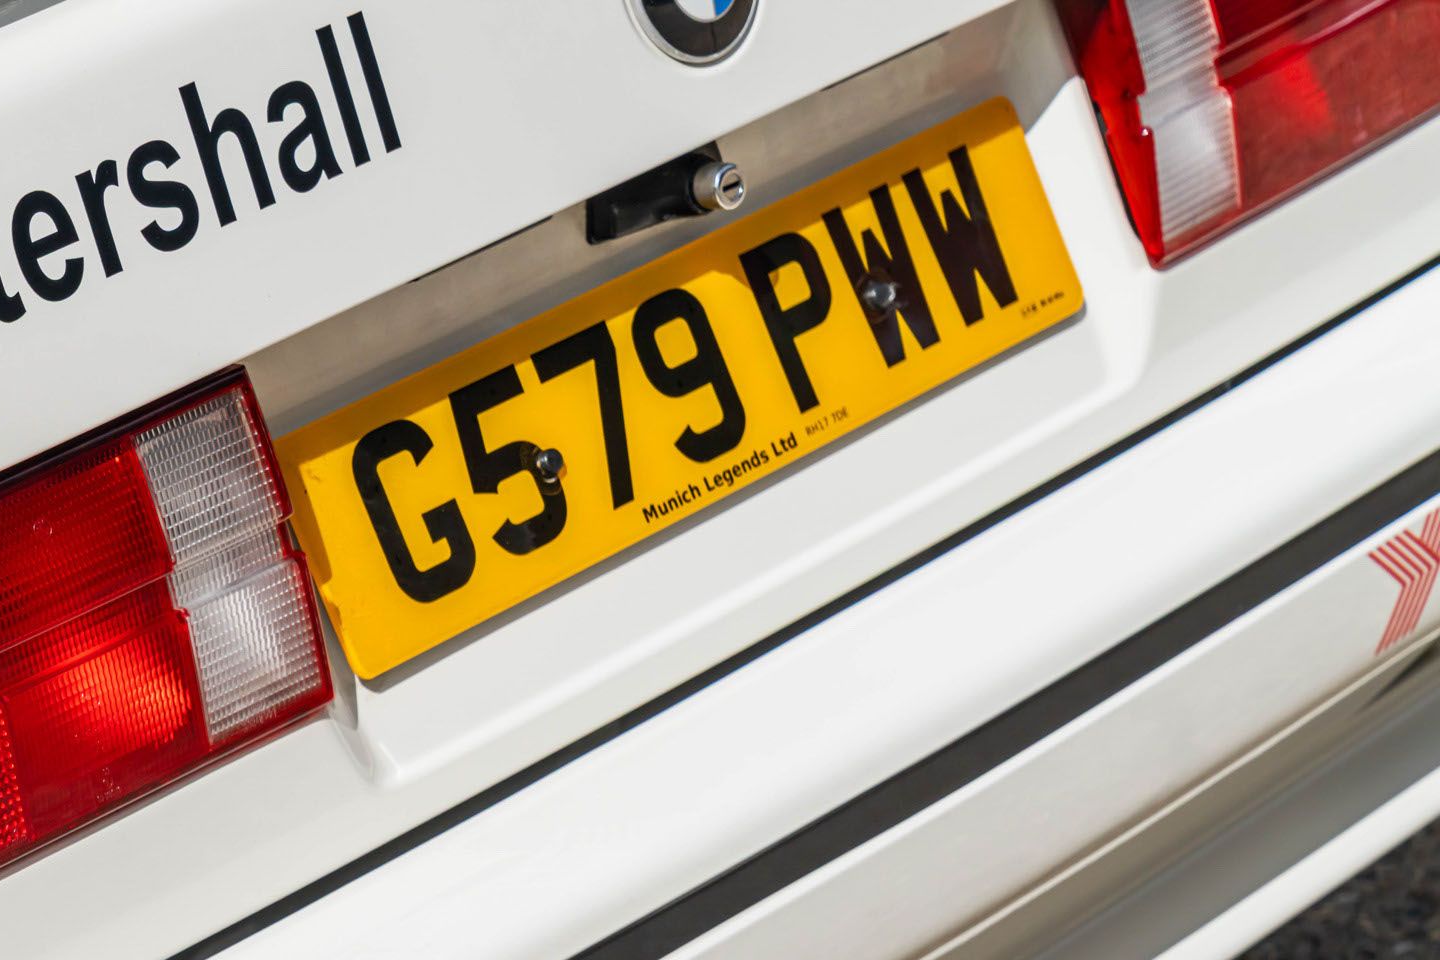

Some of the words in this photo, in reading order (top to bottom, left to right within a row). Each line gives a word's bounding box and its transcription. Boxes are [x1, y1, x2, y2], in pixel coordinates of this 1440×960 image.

[352, 287, 747, 604] G579
[740, 145, 1019, 415] PWW
[641, 483, 702, 524] Munich
[702, 448, 769, 493] Legends
[770, 430, 799, 458] Ltd
